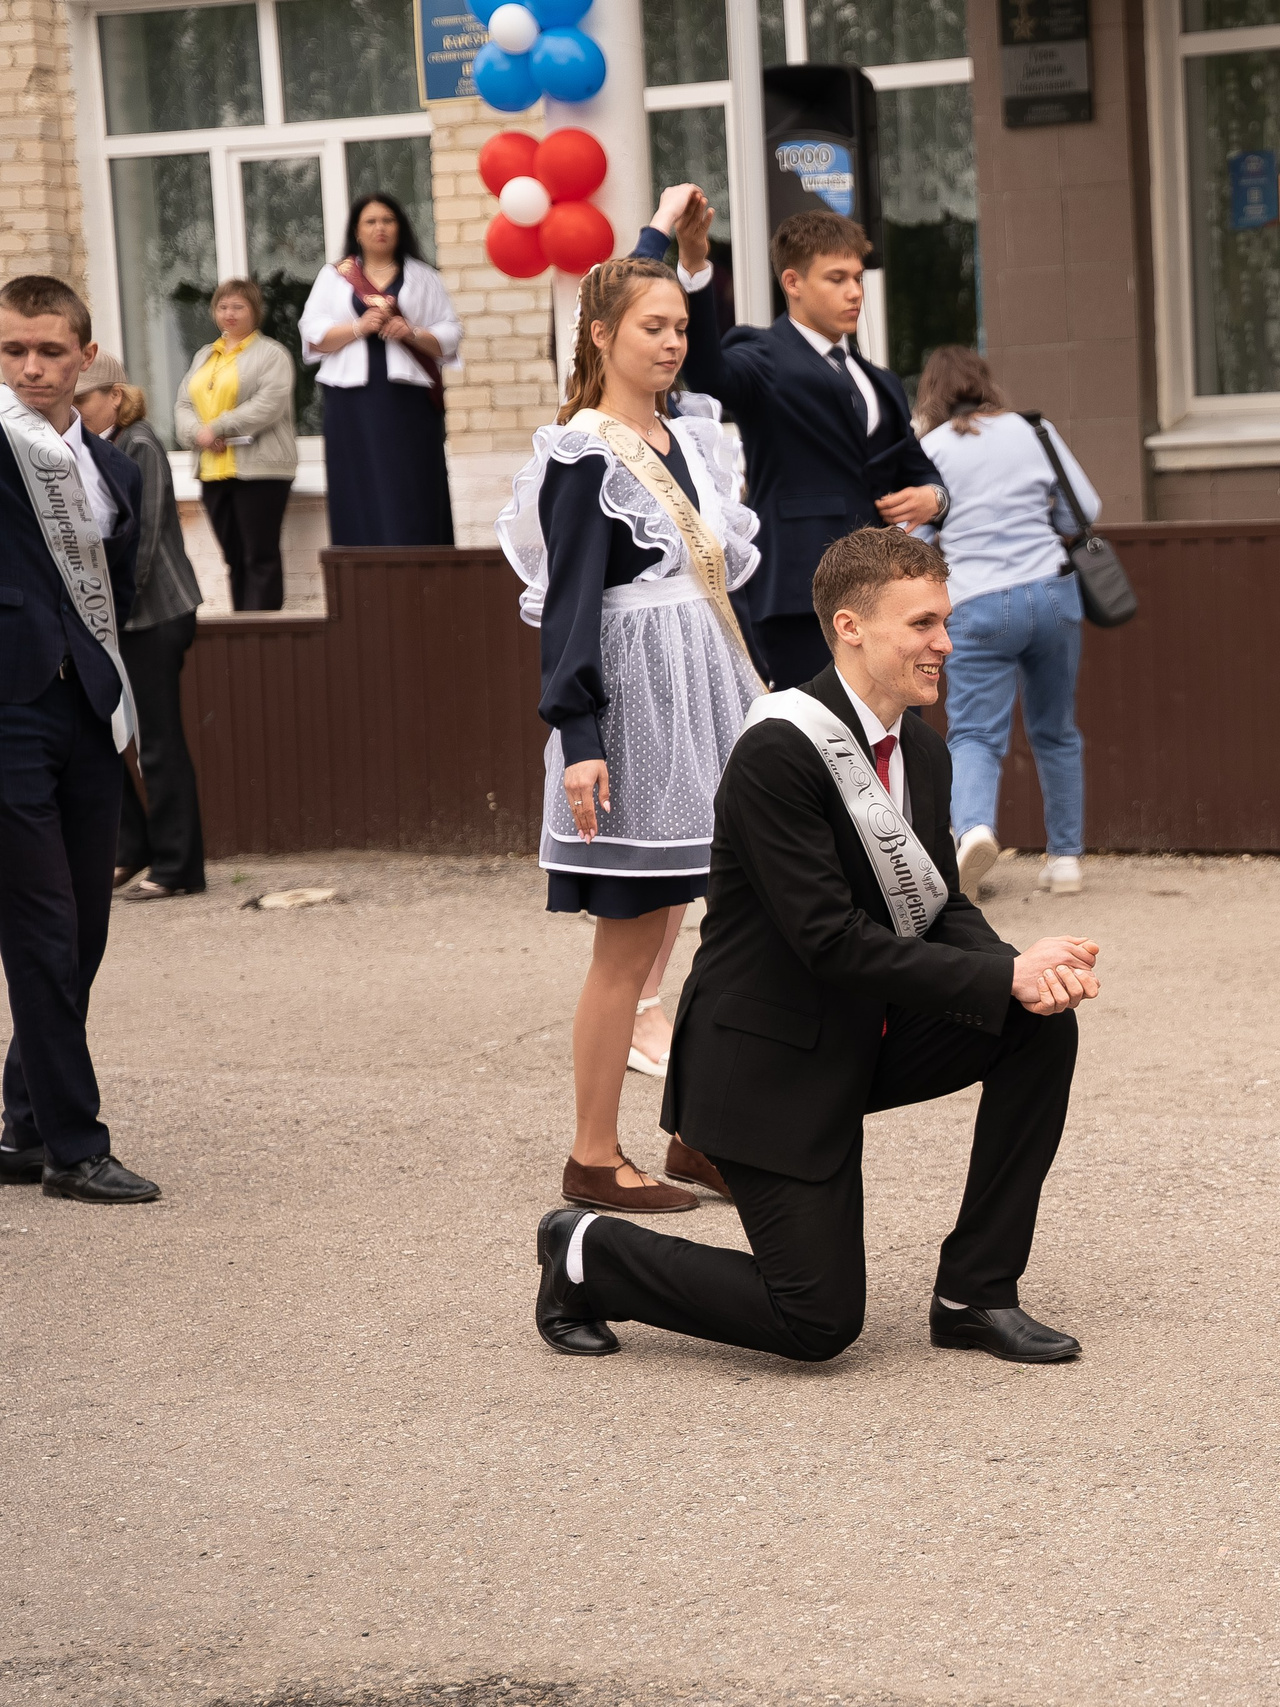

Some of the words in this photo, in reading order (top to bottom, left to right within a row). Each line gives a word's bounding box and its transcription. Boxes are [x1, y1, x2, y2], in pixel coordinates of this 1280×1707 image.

[776, 143, 836, 172] 1000
[28, 440, 85, 576] Выпускник
[77, 575, 114, 645] 2026
[821, 748, 844, 785] класс
[866, 802, 929, 938] Выпускни
